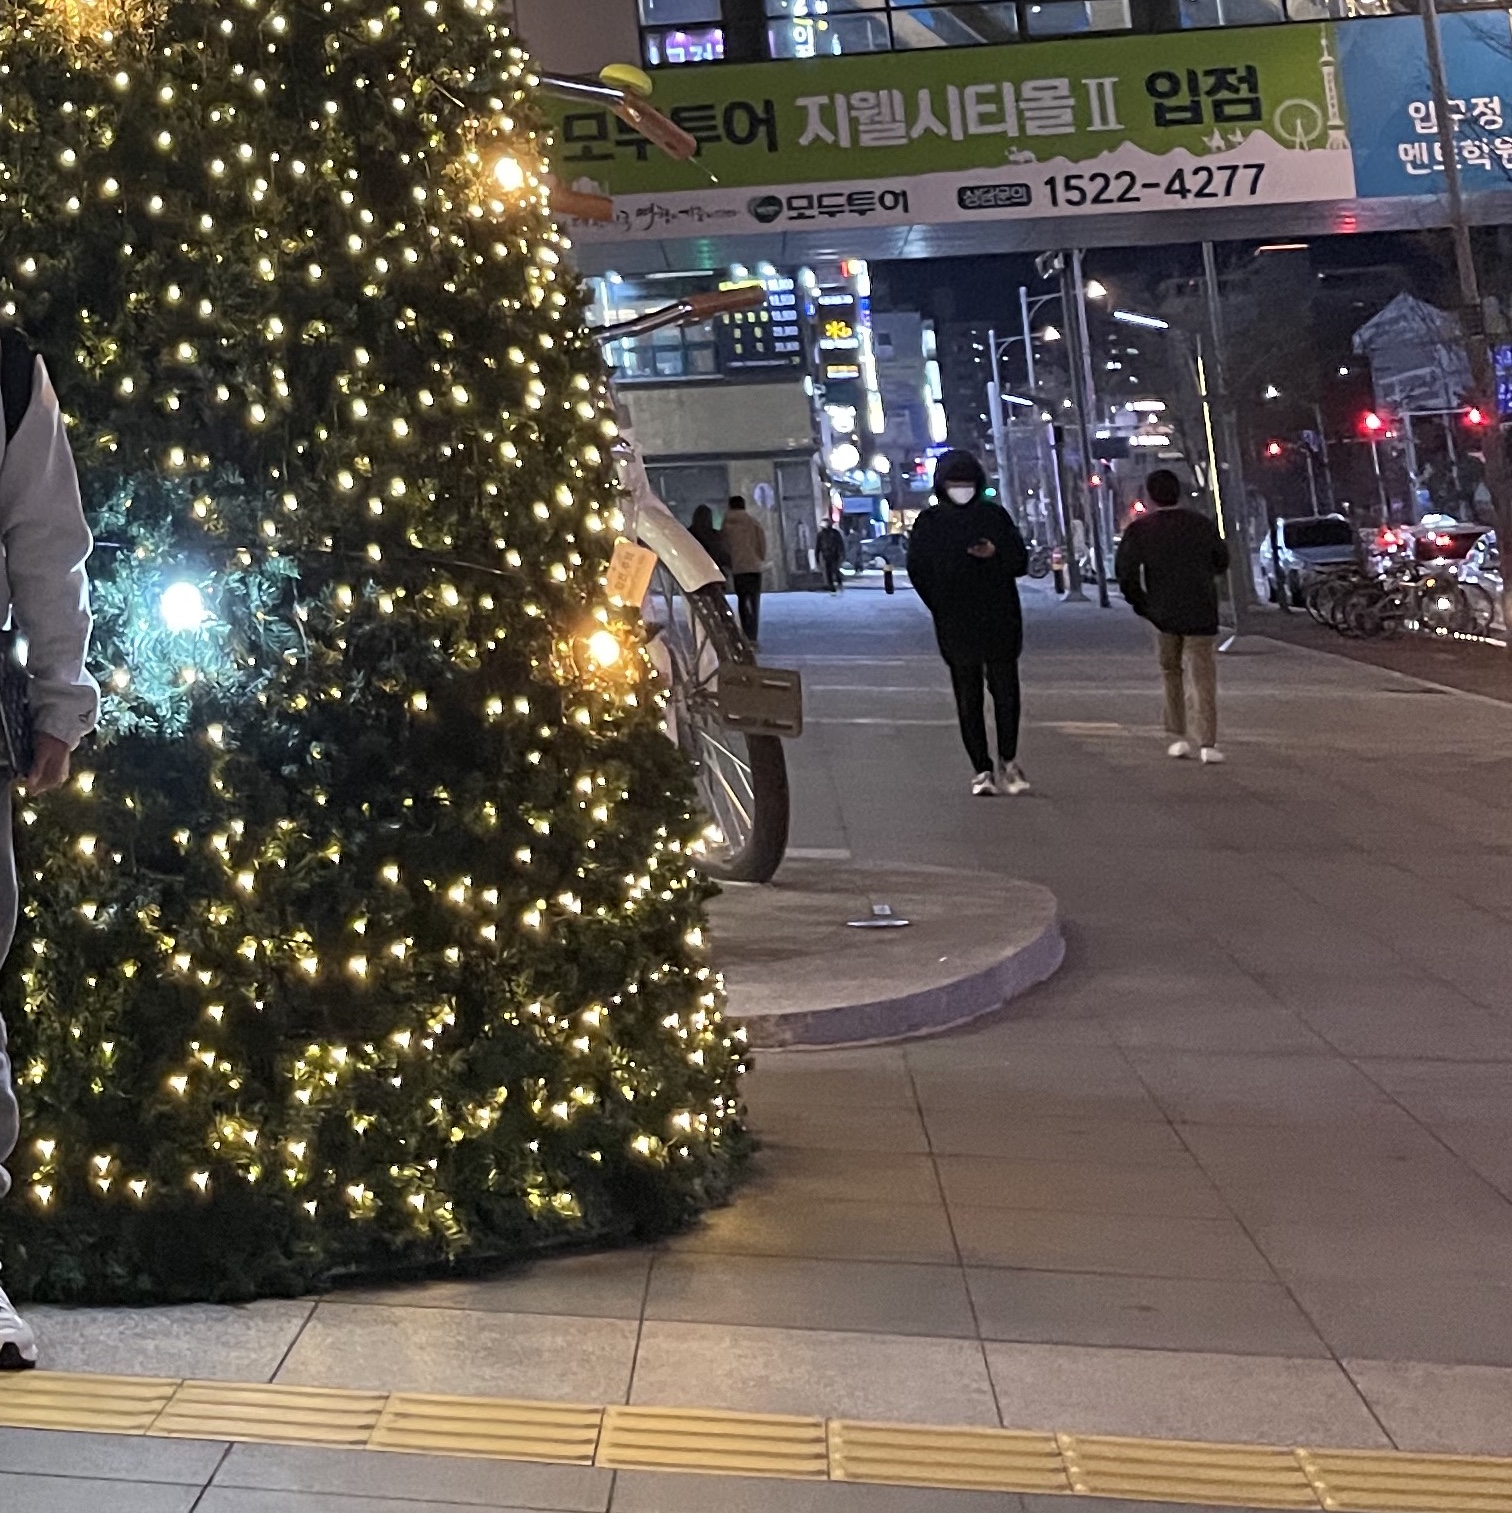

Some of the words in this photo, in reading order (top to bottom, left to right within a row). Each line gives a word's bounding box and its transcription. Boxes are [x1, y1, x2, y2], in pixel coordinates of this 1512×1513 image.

[1144, 64, 1263, 128] 입점
[786, 189, 910, 222] 모두투어
[1044, 163, 1266, 208] 1522-4277
